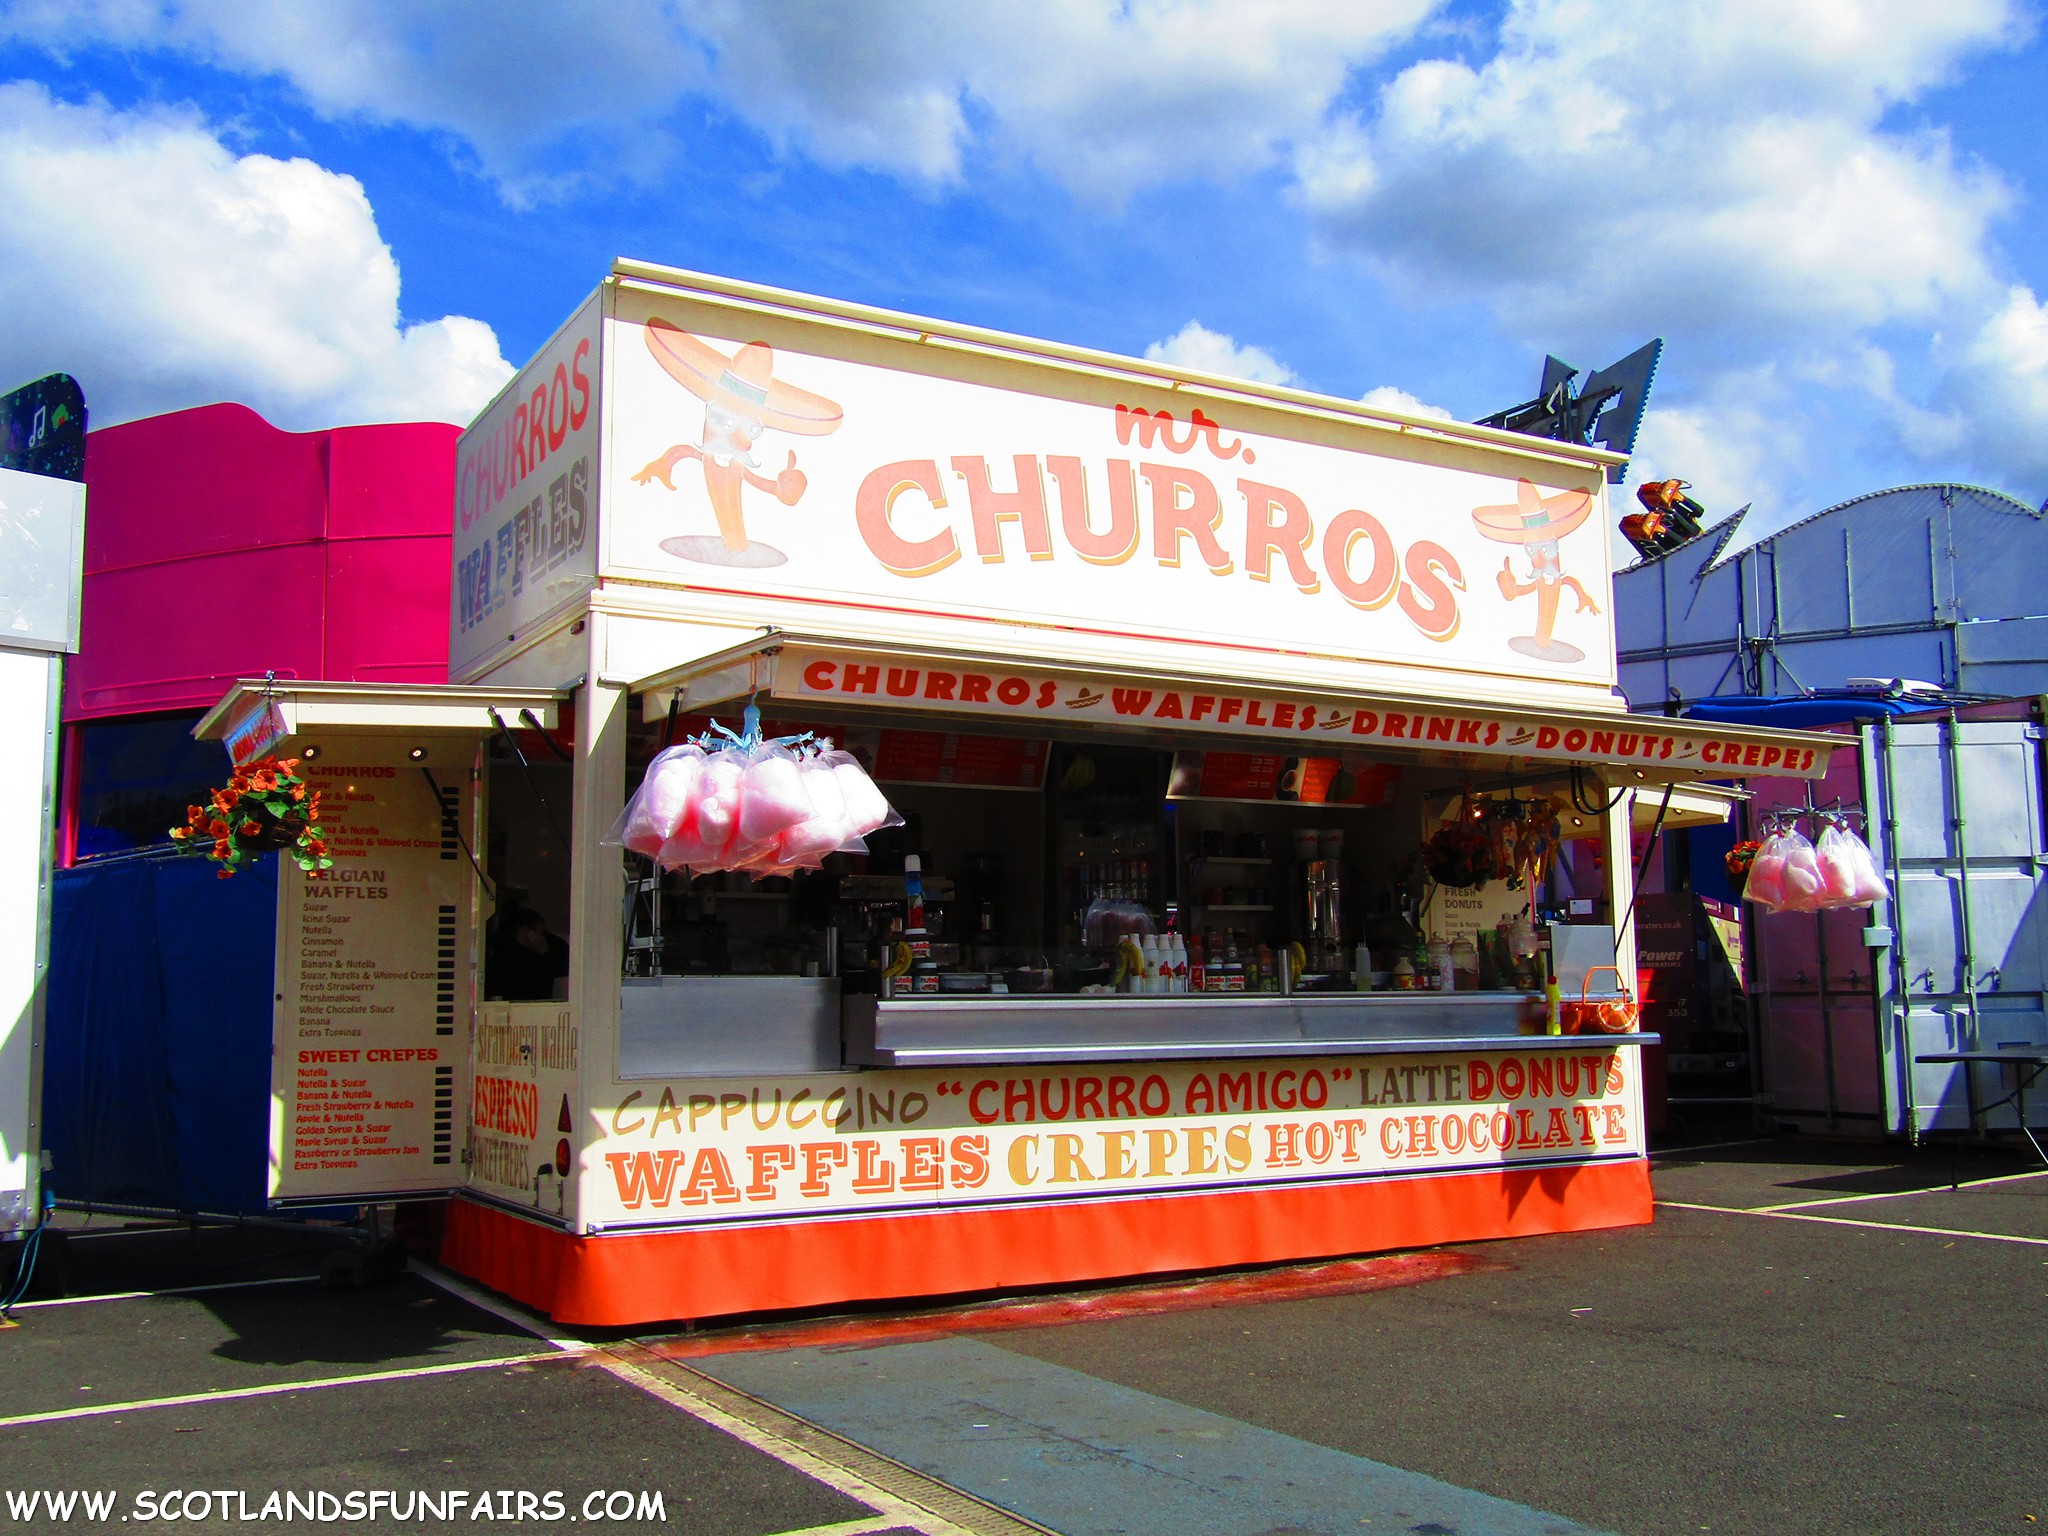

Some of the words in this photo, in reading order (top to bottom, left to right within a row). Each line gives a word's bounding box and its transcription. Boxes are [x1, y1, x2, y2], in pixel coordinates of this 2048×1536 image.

[460, 338, 590, 532] CHURROS
[1115, 402, 1256, 465] mr.
[457, 455, 588, 634] WAFFLES
[855, 453, 1467, 643] CHURROS
[802, 660, 1058, 709] CHURROS
[1111, 687, 1317, 731] WAFFLES
[1351, 710, 1500, 746] DRINKS
[1534, 725, 1675, 761] DONUTS
[1700, 741, 1816, 772] CREPES
[307, 766, 395, 778] CHURROS
[308, 780, 332, 789] Sugar
[334, 793, 343, 801] &
[346, 793, 375, 802] Nutella
[339, 826, 348, 834] &
[350, 826, 379, 835] Nutella
[334, 837, 364, 846] Nutella
[366, 838, 375, 846] &
[377, 838, 411, 848] Whipped
[413, 839, 440, 848] Cream
[330, 848, 367, 857] Toppings
[304, 886, 388, 899] WAFFLES
[1445, 887, 1476, 897] FRESH
[303, 903, 328, 912] Sugar
[1445, 899, 1483, 909] DONUTS
[302, 915, 323, 923] Icing
[325, 915, 351, 923] Sugar
[302, 926, 332, 934] Nutella
[302, 937, 344, 946] Cinnamon
[301, 949, 337, 957] Caramel
[1637, 950, 1684, 961] Power
[301, 960, 332, 969] Banana
[335, 960, 343, 968] &
[346, 960, 375, 968] Nutella
[330, 971, 360, 980] Nutella
[362, 972, 371, 980] &
[373, 971, 408, 980] Whipped
[410, 971, 437, 980] Cream
[300, 983, 324, 991] Fresh
[327, 982, 375, 991] Strawberry
[300, 994, 361, 1002] Marshmallows
[369, 1005, 395, 1013] Sauce
[1667, 1008, 1688, 1017] 353
[299, 1017, 331, 1025] Banana
[299, 1029, 322, 1037] Extra
[325, 1028, 362, 1036] Toppings
[478, 1012, 538, 1078] strawberry
[541, 1011, 578, 1071] waffle
[298, 1050, 360, 1063] SWEET
[366, 1048, 438, 1062] CREPES
[297, 1068, 328, 1077] Nutella
[297, 1079, 328, 1088] Nutella
[330, 1079, 339, 1088] &
[342, 1079, 367, 1088] Sugar
[297, 1091, 329, 1100] Banana
[331, 1090, 339, 1099] &
[342, 1090, 372, 1099] Nutella
[610, 1085, 929, 1139] CAPPUCCINO
[1360, 1065, 1462, 1106] LATTE
[1467, 1054, 1624, 1101] DONUTS
[296, 1103, 321, 1111] Fresh
[323, 1102, 372, 1111] Strawberry
[374, 1101, 382, 1109] &
[384, 1100, 414, 1109] Nutella
[474, 1075, 538, 1140] ESPRESSO
[296, 1114, 320, 1123] Apple
[323, 1114, 332, 1122] &
[334, 1113, 364, 1122] Nutella
[295, 1126, 325, 1135] Golden
[327, 1125, 353, 1134] Syrup
[355, 1125, 363, 1133] &
[367, 1124, 392, 1133] Sugar
[295, 1138, 321, 1147] Maple
[323, 1137, 349, 1146] Syrup
[351, 1136, 360, 1145] &
[362, 1135, 388, 1144] Sugar
[294, 1148, 339, 1159] Raspberry
[341, 1149, 351, 1157] or
[353, 1147, 401, 1156] Strawberry
[403, 1146, 419, 1155] Jam
[605, 1134, 990, 1210] WAFFLES
[1006, 1122, 1252, 1187] CREPES
[1264, 1117, 1367, 1168] HOT
[1379, 1103, 1627, 1158] CHOCOLATE
[294, 1161, 318, 1170] Extra
[320, 1160, 358, 1169] Toppings
